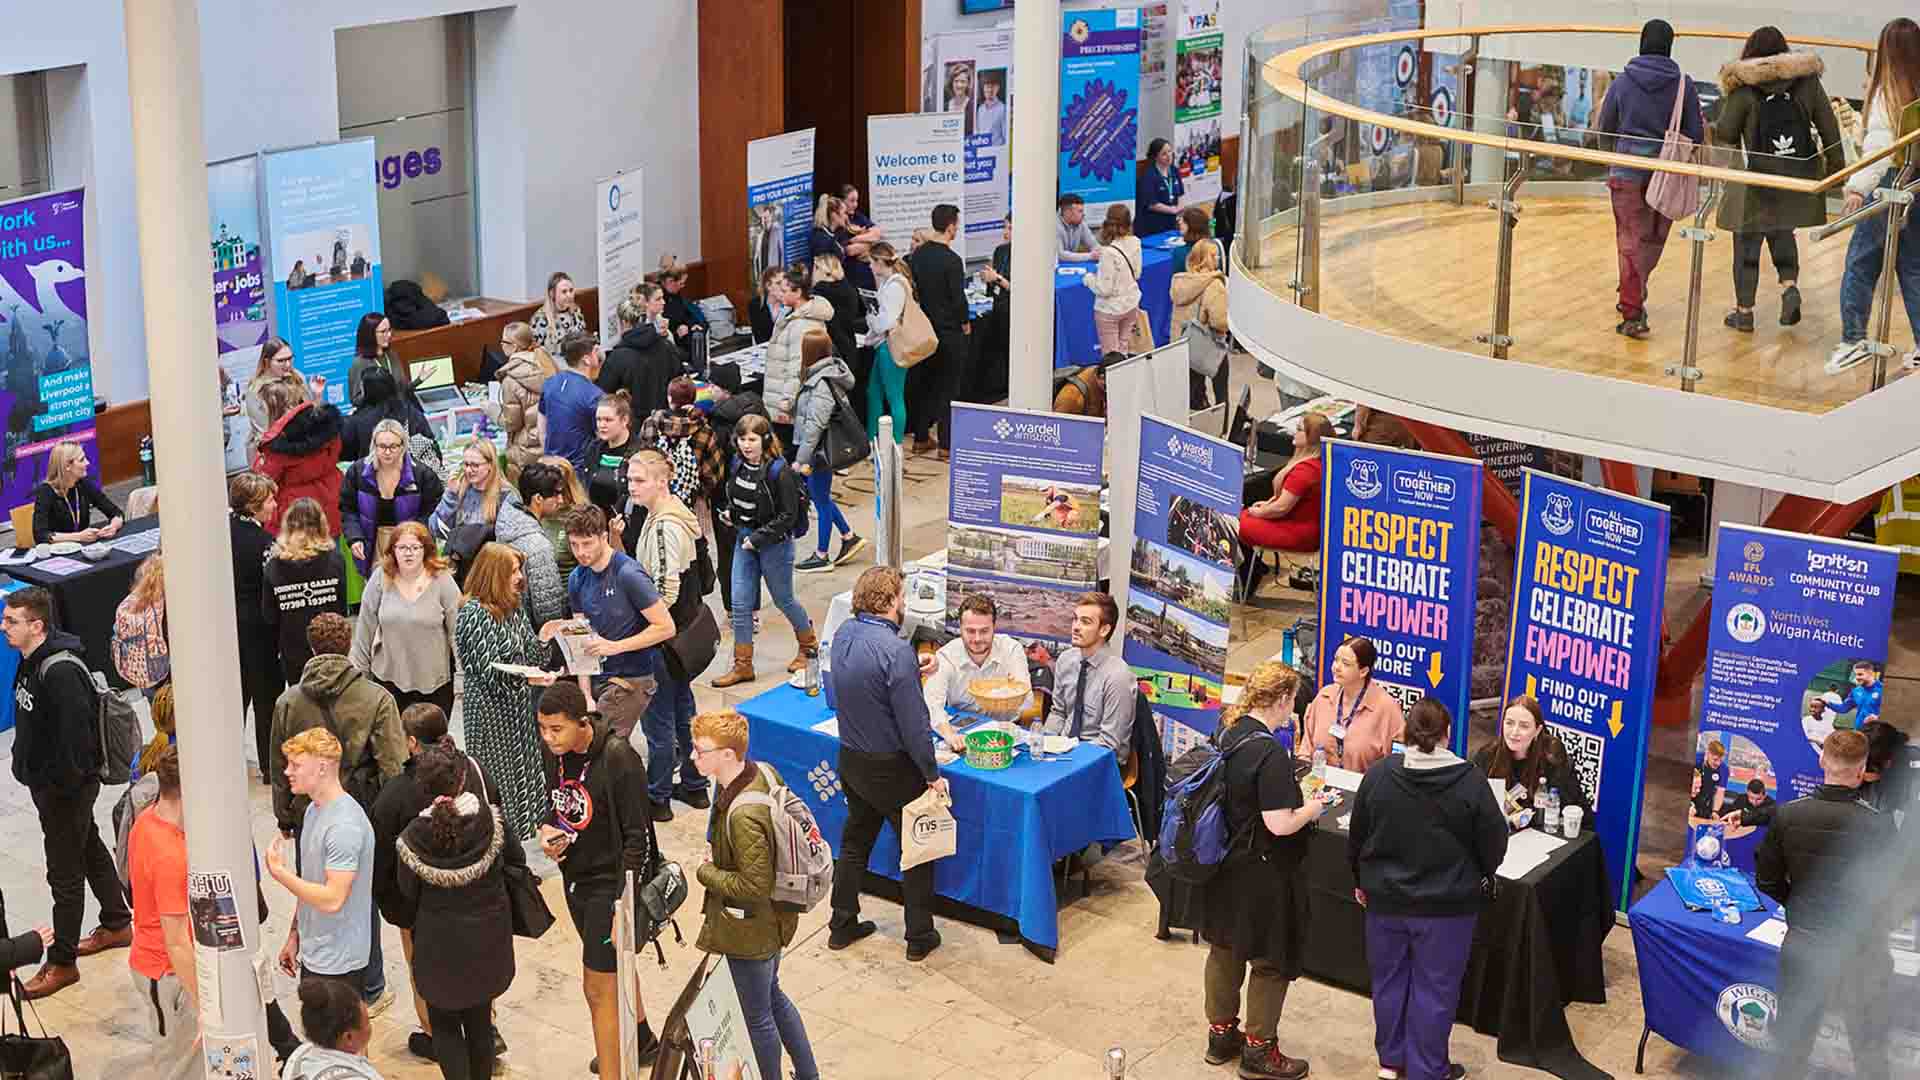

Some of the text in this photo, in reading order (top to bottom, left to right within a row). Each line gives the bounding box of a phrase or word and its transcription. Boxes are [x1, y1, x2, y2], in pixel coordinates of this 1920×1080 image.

[1188, 14, 1217, 29] YPAS
[875, 153, 938, 168] Welcome
[942, 152, 956, 164] to
[977, 159, 993, 171] you
[876, 170, 959, 187] Mersey Care
[0, 234, 72, 261] ith us...
[233, 272, 261, 295] jobs
[44, 375, 62, 388] And
[40, 383, 84, 401] Liverpool
[40, 406, 91, 425] vibrant city
[1014, 430, 1061, 446] armstrong
[1015, 422, 1061, 436] wardell
[1183, 440, 1214, 459] wardell
[1417, 469, 1433, 481] ALL
[1399, 476, 1451, 495] TOGETHER
[1414, 490, 1435, 501] NOW
[1608, 510, 1622, 522] ALL
[1342, 506, 1454, 563] RESPECT
[1590, 515, 1639, 539] TOGETHER
[1604, 531, 1623, 544] NOW
[1743, 562, 1761, 574] EFL
[1807, 548, 1869, 575] ignition
[1341, 550, 1451, 601] CELEBRATE
[1534, 541, 1640, 609] RESPECT
[1728, 571, 1776, 587] AWARDS
[1789, 572, 1881, 597] COMMUNITY CLUB
[273, 582, 309, 596] JOHNNY'S
[310, 578, 339, 588] GARAGE
[1802, 586, 1865, 607] OF THE YEAR
[1339, 586, 1449, 641] EMPOWER
[1529, 587, 1635, 649] CELEBRATE
[1770, 608, 1801, 623] North
[1802, 613, 1832, 628] West
[1768, 621, 1865, 649] Wigan Athletic
[1396, 642, 1426, 662] OUT
[1524, 624, 1632, 691] EMPOWER
[1373, 657, 1413, 678] MORE
[1540, 676, 1609, 710] FIND OUT
[1550, 697, 1593, 725] MORE
[919, 820, 937, 832] TVS
